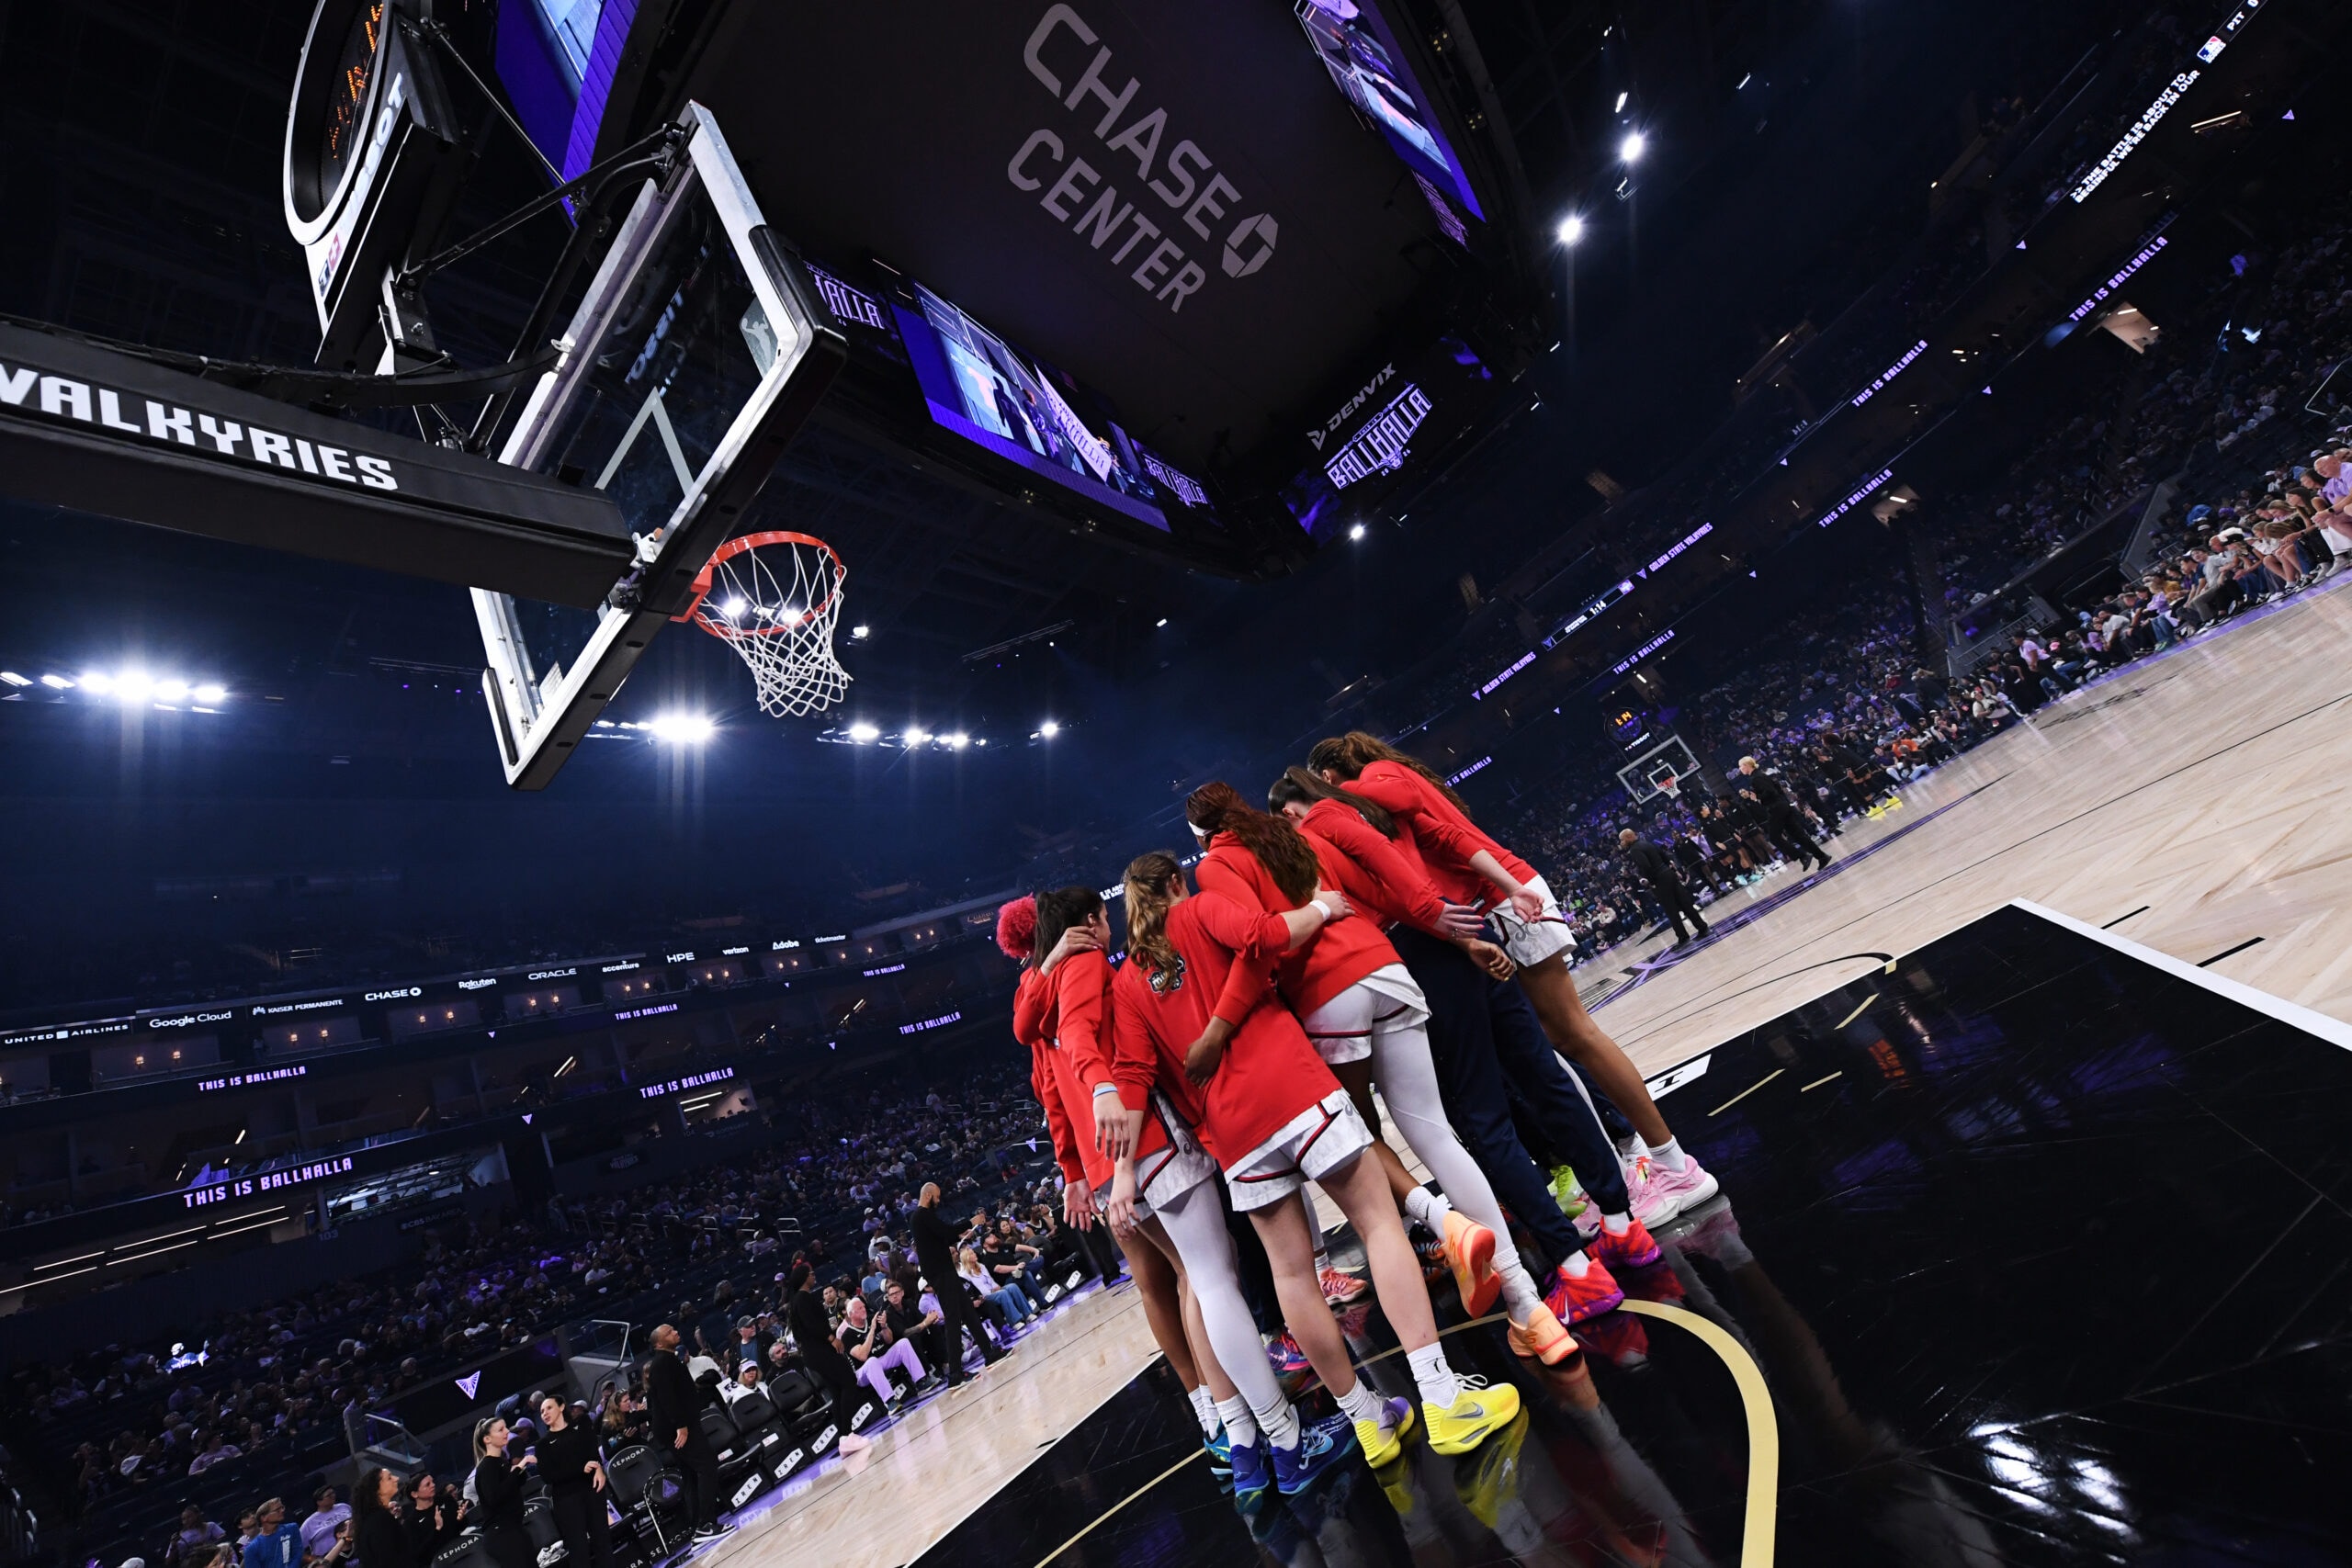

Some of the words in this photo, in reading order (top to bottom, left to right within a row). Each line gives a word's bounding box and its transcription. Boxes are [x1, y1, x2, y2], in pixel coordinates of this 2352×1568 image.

[2227, 11, 2245, 30] PIT
[1023, 3, 1241, 242] CHASE
[2081, 166, 2102, 186] THE
[2100, 133, 2134, 167] BATTLE
[2131, 122, 2144, 134] IS
[2143, 87, 2176, 122] ABOUT
[2170, 73, 2188, 87] TO
[2075, 161, 2120, 203] BEGINFUL
[2115, 130, 2145, 159] WE'RE
[2142, 105, 2169, 131] BACK
[2165, 92, 2180, 106] IN
[2177, 71, 2199, 92] OUR
[1008, 129, 1206, 312] CENTER
[2069, 299, 2095, 321] THIS
[2095, 288, 2109, 300] IS
[2108, 237, 2167, 288] BALLHALLA
[1852, 389, 1872, 406] THIS
[1872, 379, 1883, 389] IS
[1883, 340, 1928, 380] BALLHALLA
[1327, 362, 1396, 432] DENVIX
[0, 362, 398, 491] VALKYRIES
[1327, 388, 1432, 490] BALLHALLA
[1819, 512, 1838, 527] THIS
[1838, 503, 1849, 513] IS
[1848, 469, 1892, 505] BALLHALLA
[1649, 554, 1670, 571] GOLDEN
[1668, 542, 1687, 558] STATE
[1684, 523, 1713, 546] VALKYRIES
[1589, 599, 1607, 616] 1:14
[1613, 661, 1629, 674] THIS
[1630, 655, 1638, 663] IS
[1638, 630, 1674, 658] BALLHALLA
[1482, 678, 1500, 694] GOLDEN
[1498, 668, 1514, 682] STATE
[1511, 652, 1536, 671] VALKYRIES
[1631, 732, 1650, 747] TISSOT
[1460, 757, 1491, 779] BALLHALLA
[722, 946, 749, 955] verizon
[772, 940, 799, 950] Adobe
[602, 961, 639, 973] accenture
[666, 952, 695, 964] HPE
[880, 964, 905, 974] BALLHALLA
[1107, 954, 1116, 964] IS
[458, 977, 497, 989] Rakuten
[528, 968, 577, 980] ORACLE
[365, 988, 409, 1001] CHASE
[267, 1005, 294, 1014] KAISER
[295, 999, 344, 1011] PERMANENTE
[642, 1004, 677, 1015] BALLHALLA
[149, 1015, 196, 1029] Google
[197, 1011, 232, 1023] Cloud
[899, 1024, 915, 1034] THIS
[924, 1012, 960, 1028] BALLHALLA
[4, 1032, 54, 1044] UNITED
[71, 1024, 129, 1036] AIRLINES
[198, 1079, 225, 1090] THIS
[230, 1077, 241, 1086] IS
[246, 1066, 305, 1083] BALLHALLA
[640, 1084, 664, 1098] THIS
[668, 1081, 678, 1091] IS
[682, 1067, 733, 1088] BALLHALLA
[184, 1187, 226, 1207] THIS
[235, 1180, 252, 1196] IS
[261, 1157, 352, 1190] BALLHALLA
[317, 1228, 339, 1241] 103
[407, 1218, 424, 1228] CBS
[851, 1404, 870, 1428] IREN
[815, 1427, 835, 1451] IREN
[612, 1447, 646, 1468] SEPHORA
[777, 1451, 800, 1476] IREN
[735, 1476, 759, 1506] IREN
[437, 1535, 480, 1562] SEPHORA
